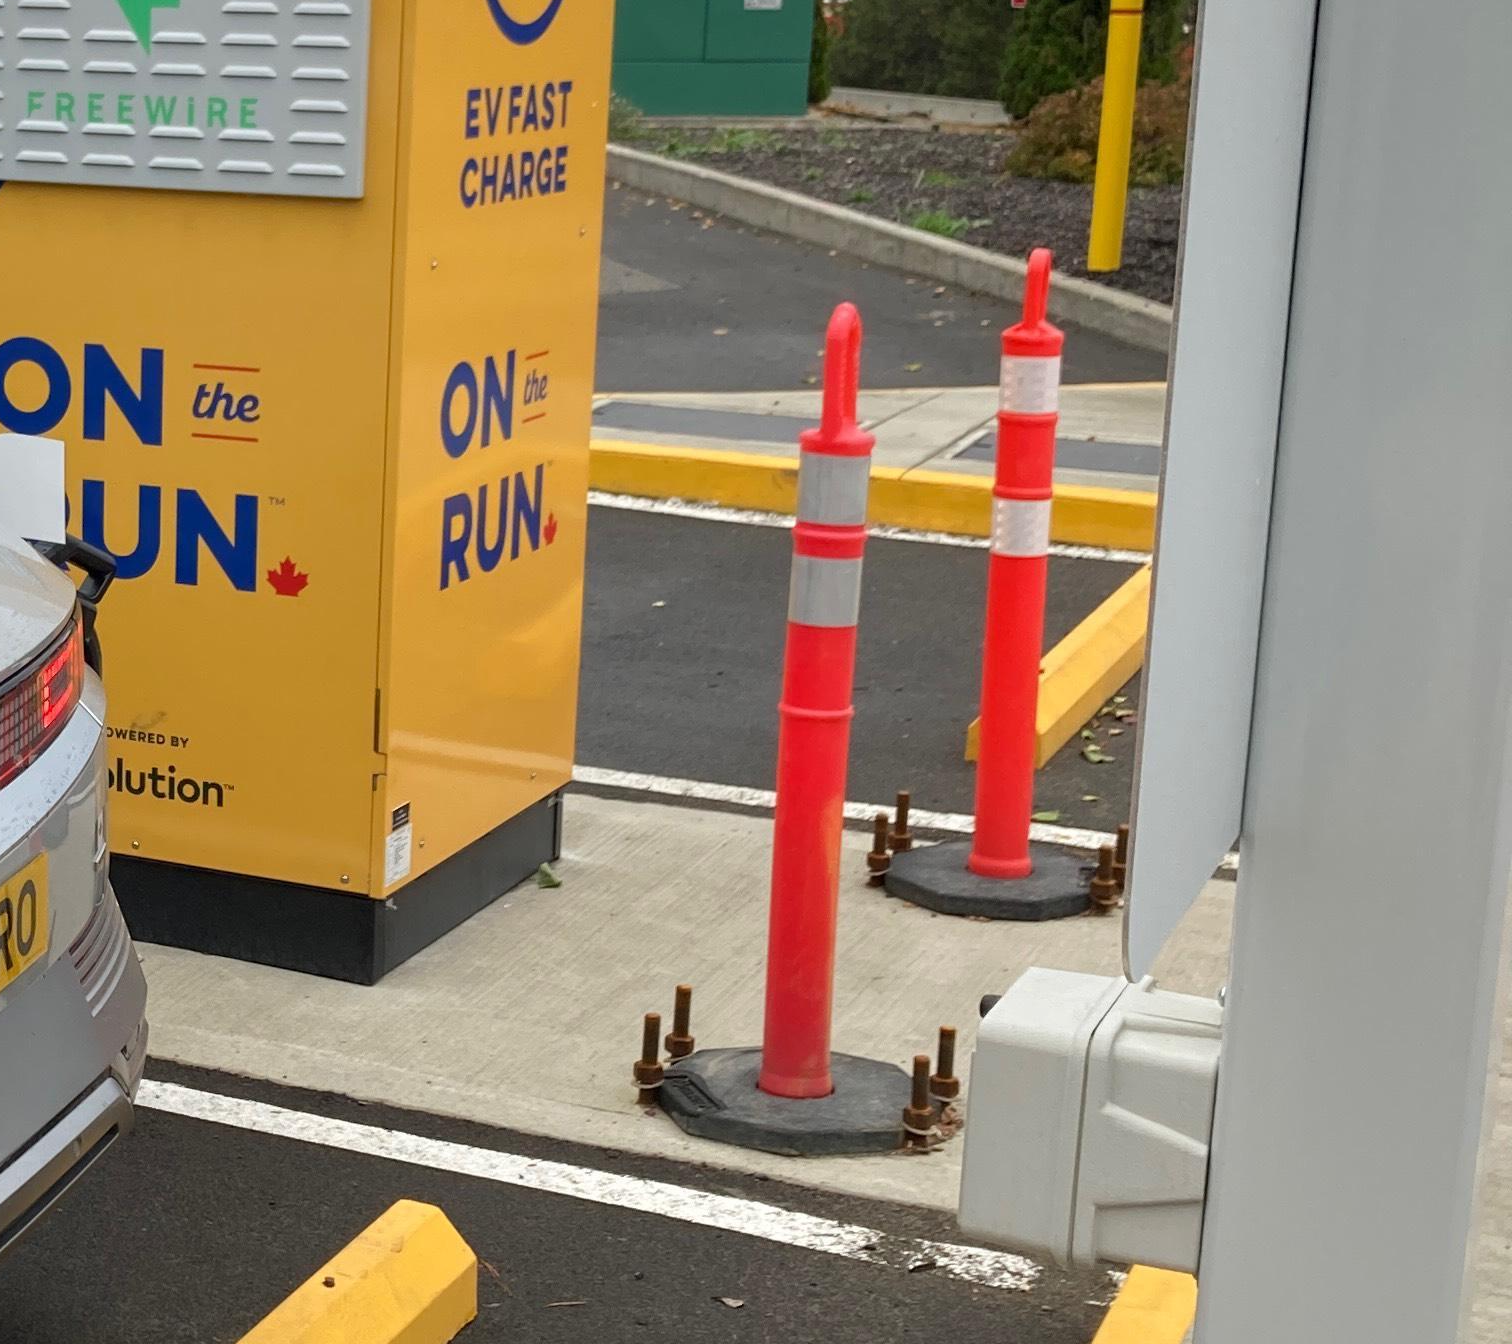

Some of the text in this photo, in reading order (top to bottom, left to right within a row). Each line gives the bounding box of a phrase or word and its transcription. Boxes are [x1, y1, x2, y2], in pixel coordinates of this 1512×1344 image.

[464, 80, 573, 140] EV FAST
[459, 145, 569, 209] CHARGE
[191, 382, 261, 423] the
[440, 348, 548, 459] ON the
[64, 479, 259, 592] UN
[439, 463, 545, 592] RUN
[106, 726, 190, 749] OWERED BY
[108, 757, 224, 808] lution
